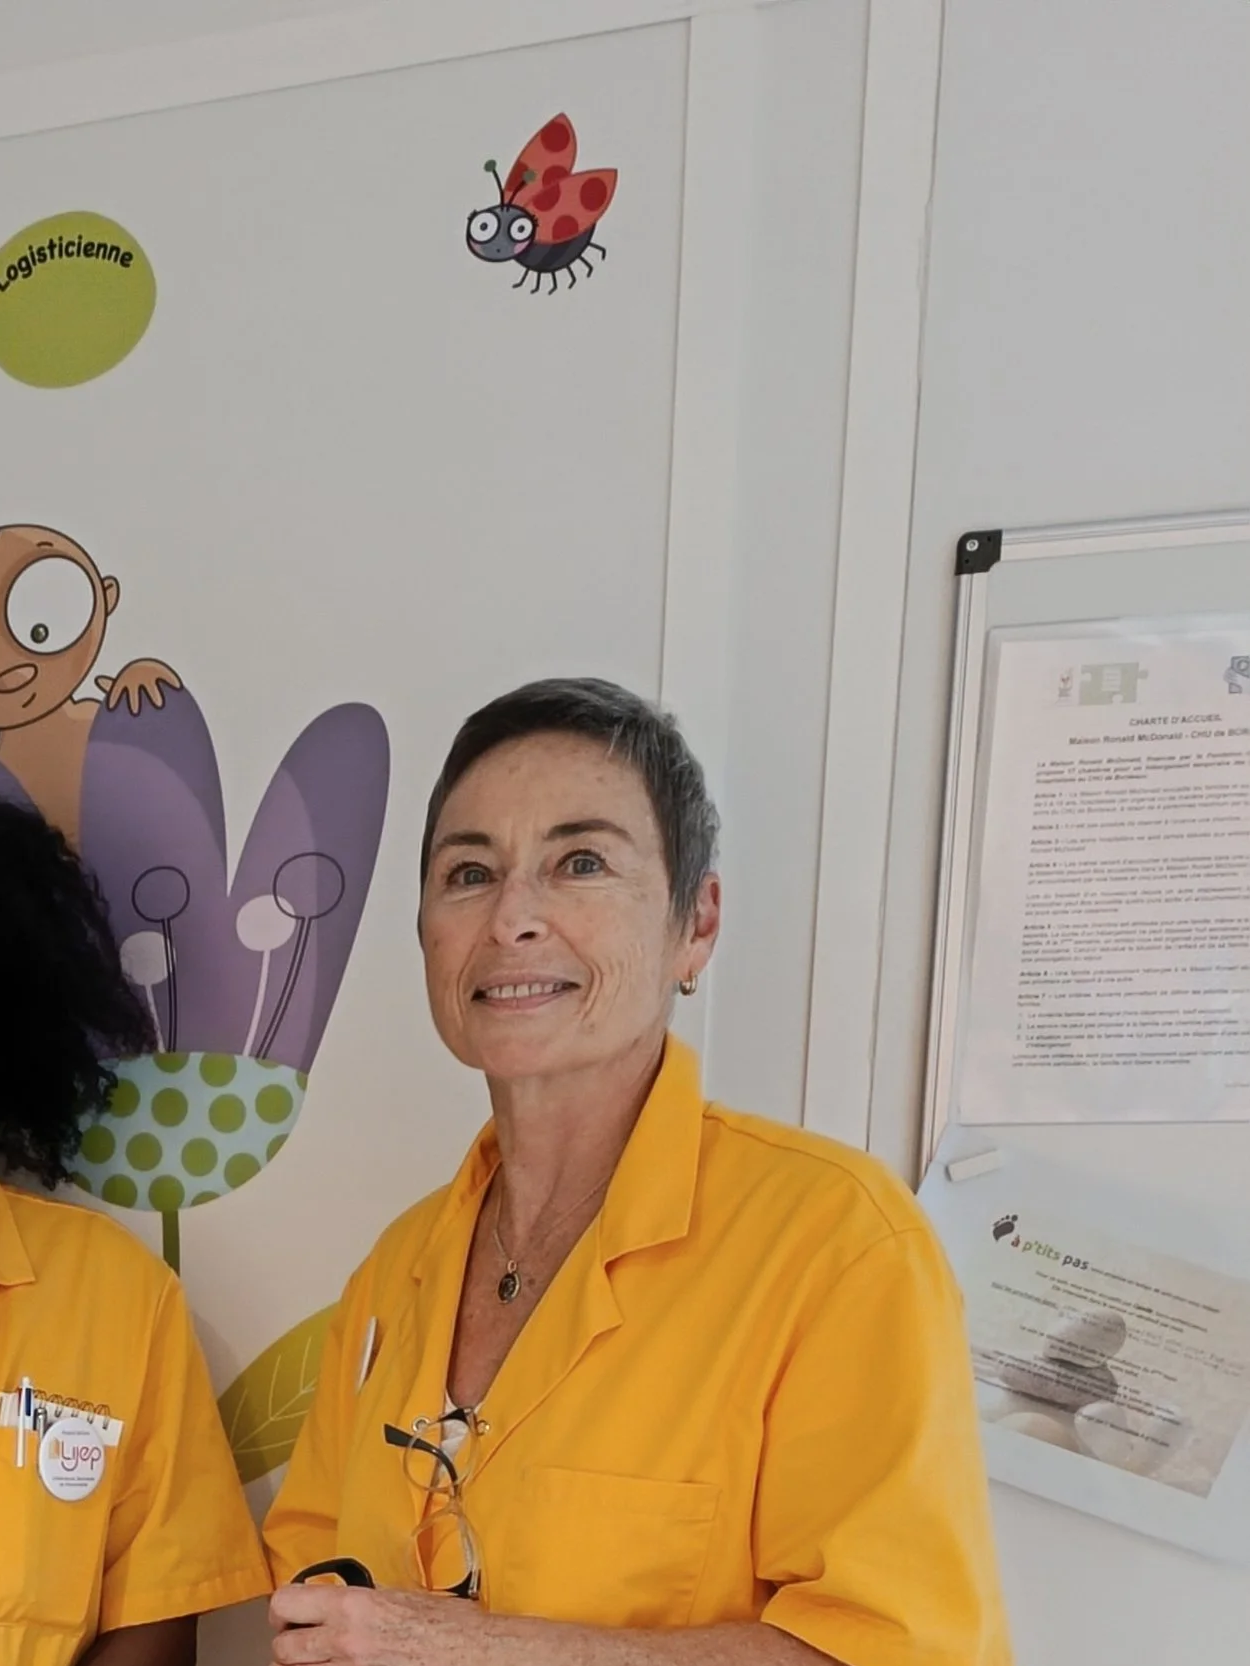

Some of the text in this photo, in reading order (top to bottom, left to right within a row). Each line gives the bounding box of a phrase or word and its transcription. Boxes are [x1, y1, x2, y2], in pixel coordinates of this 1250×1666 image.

[1129, 716, 1169, 726] CHARTE
[1137, 732, 1183, 742] McDonald
[1022, 1240, 1061, 1261] p'tits
[1062, 1254, 1090, 1270] pas
